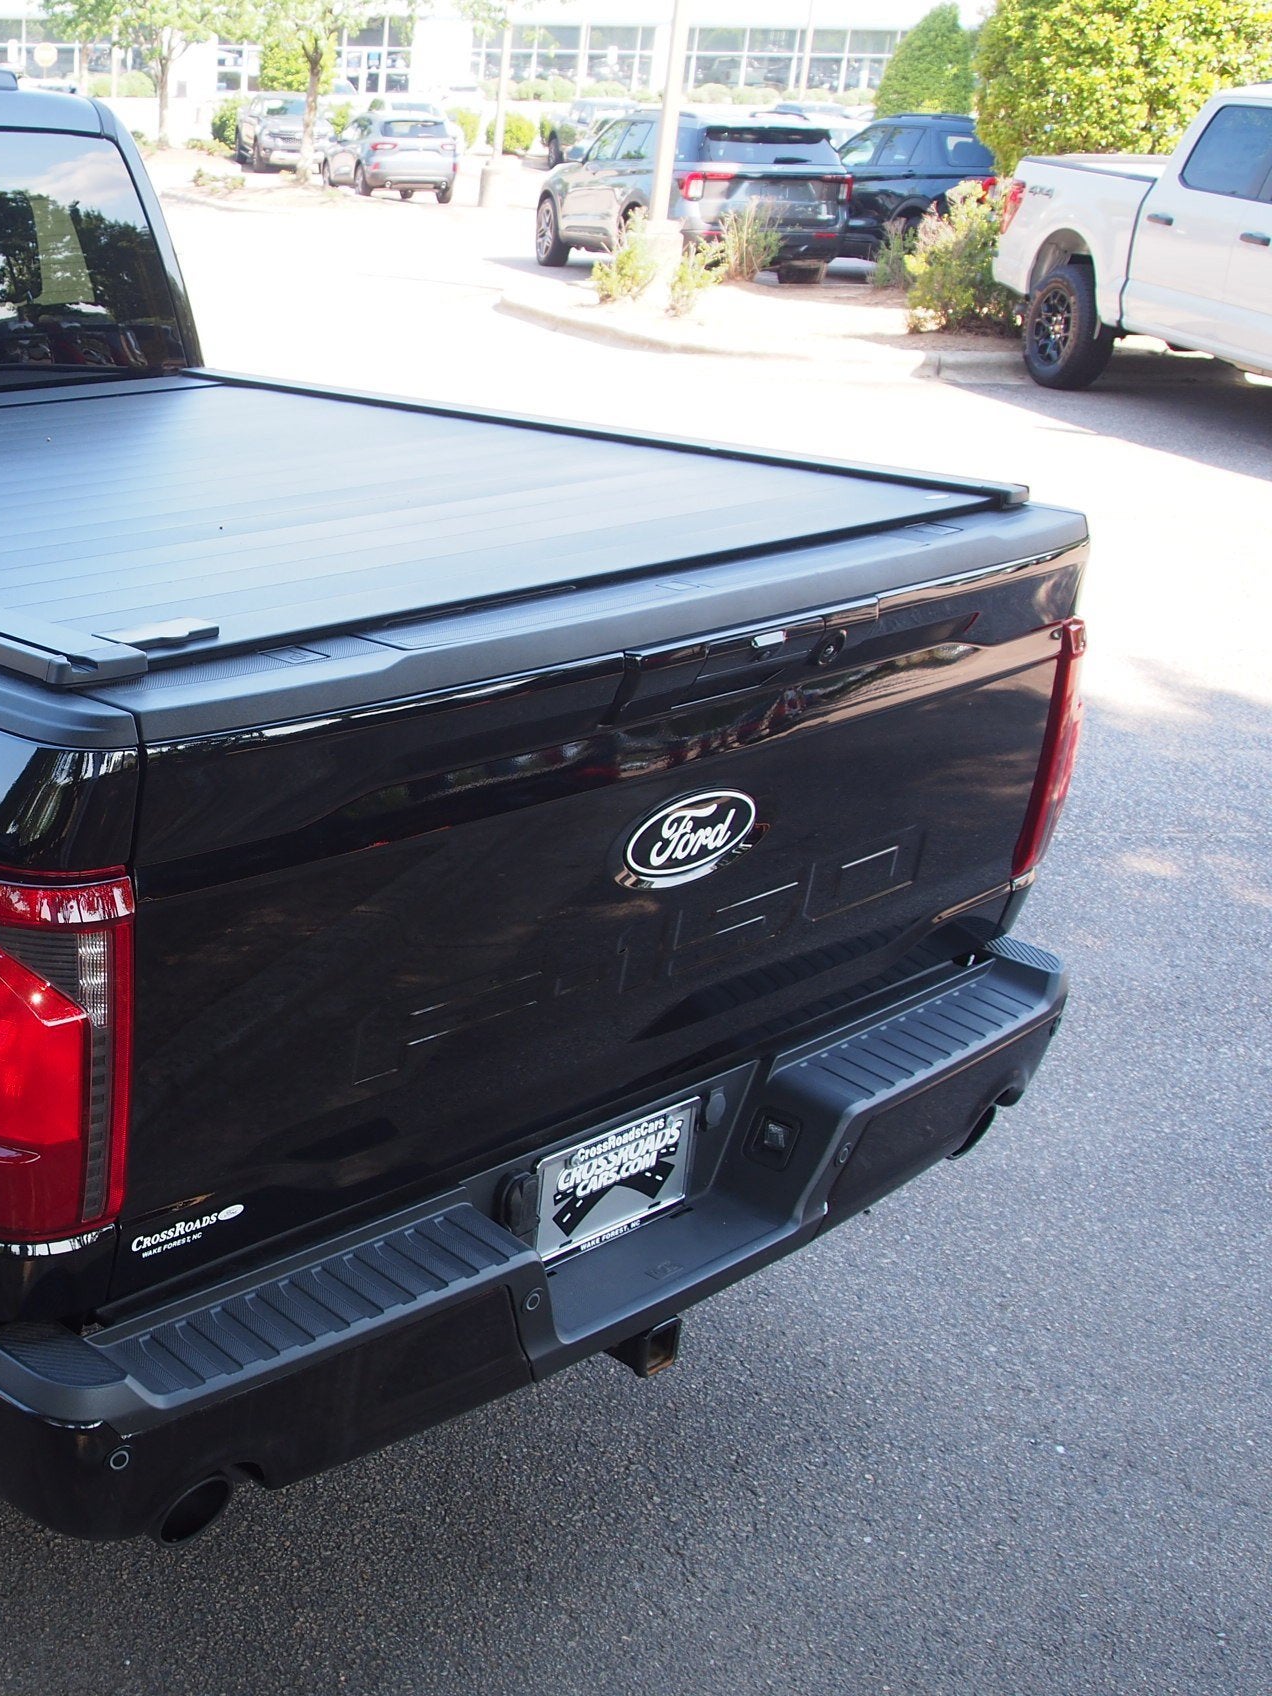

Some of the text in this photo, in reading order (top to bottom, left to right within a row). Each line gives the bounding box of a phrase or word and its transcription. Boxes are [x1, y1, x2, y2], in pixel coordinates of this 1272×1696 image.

[649, 803, 736, 867] Ford
[557, 1118, 684, 1192] CROSSROADS
[575, 1151, 658, 1198] CARS.COM
[141, 1231, 203, 1259] WAKE FOREST, NC
[580, 1219, 641, 1251] WAKE FOREST, NC
